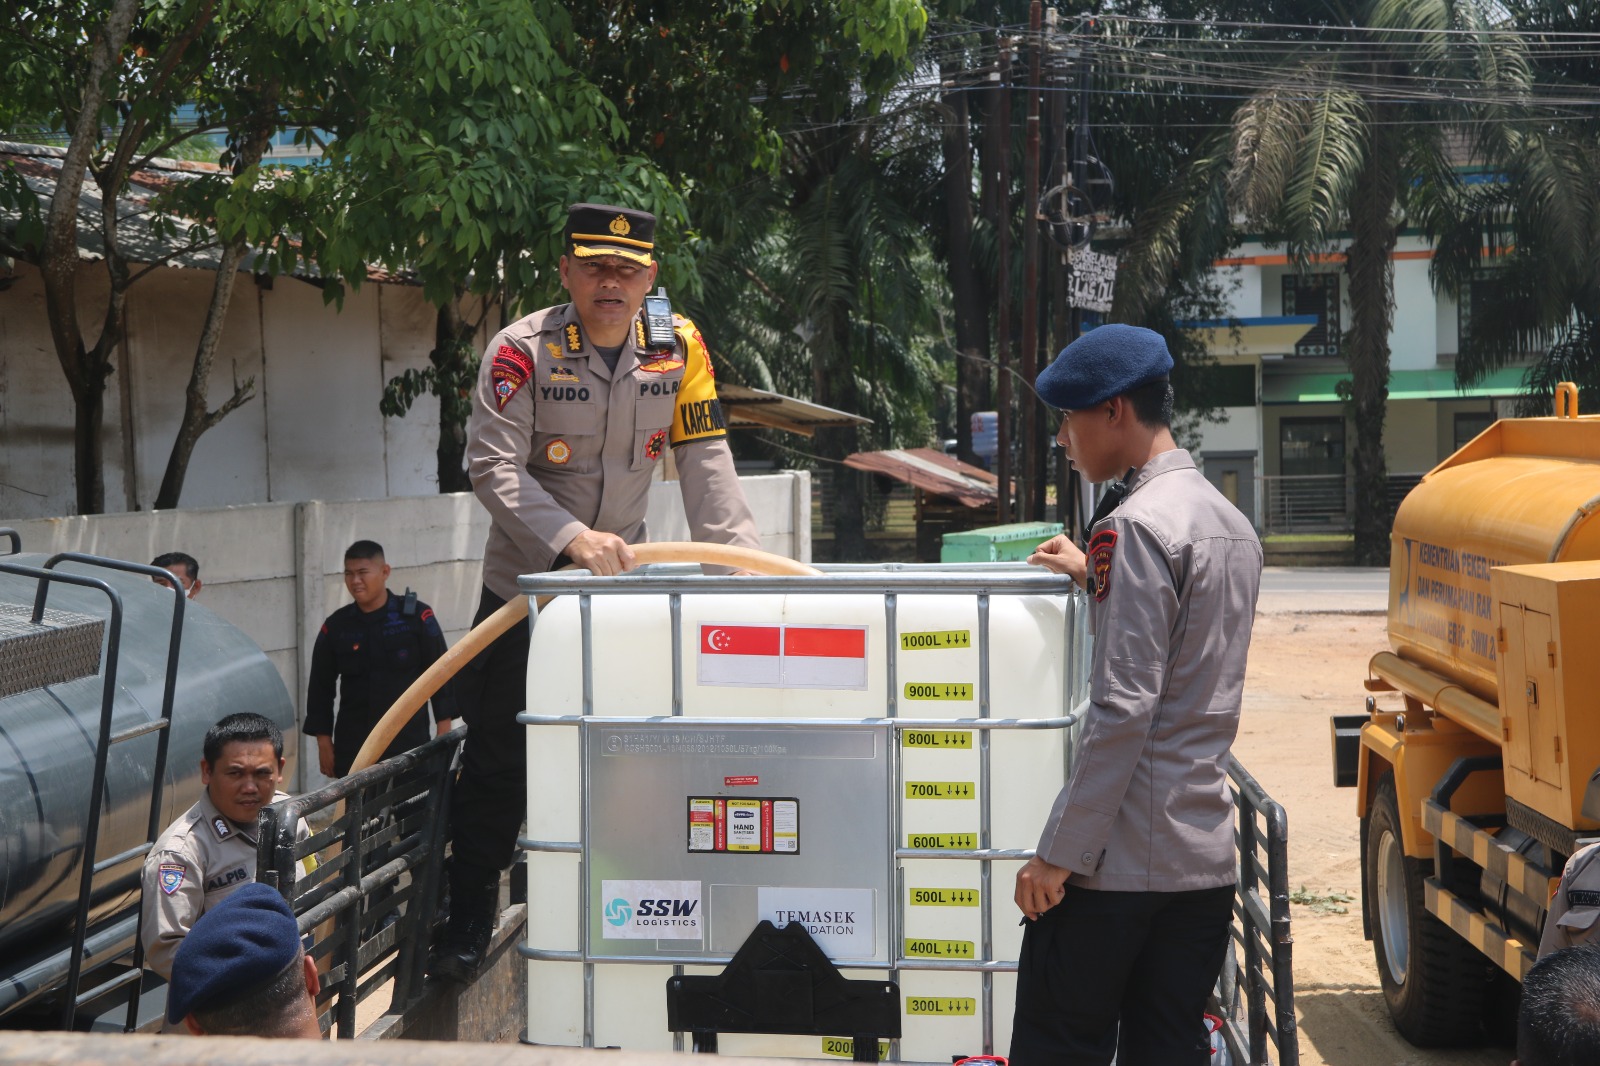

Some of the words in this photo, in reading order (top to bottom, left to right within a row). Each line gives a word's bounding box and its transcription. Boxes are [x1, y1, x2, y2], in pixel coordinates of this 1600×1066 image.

[541, 387, 590, 401] YUDO
[1419, 542, 1460, 575] KEMENTRIAN
[1417, 576, 1430, 600] DAN
[1431, 580, 1474, 615] PERUMAHAN
[903, 634, 941, 647] 1000L
[909, 685, 940, 698] 900L
[908, 733, 939, 745] 800L
[911, 784, 942, 796] 700L
[913, 836, 944, 848] 600L
[207, 868, 247, 890] ALPIS
[915, 891, 946, 903] 500L
[637, 899, 698, 916] SSW
[637, 919, 697, 927] LOGISTICS
[775, 910, 856, 924] TEMASEK
[778, 925, 854, 935] DATION
[910, 942, 942, 954] 400L
[912, 1000, 943, 1012] 300L
